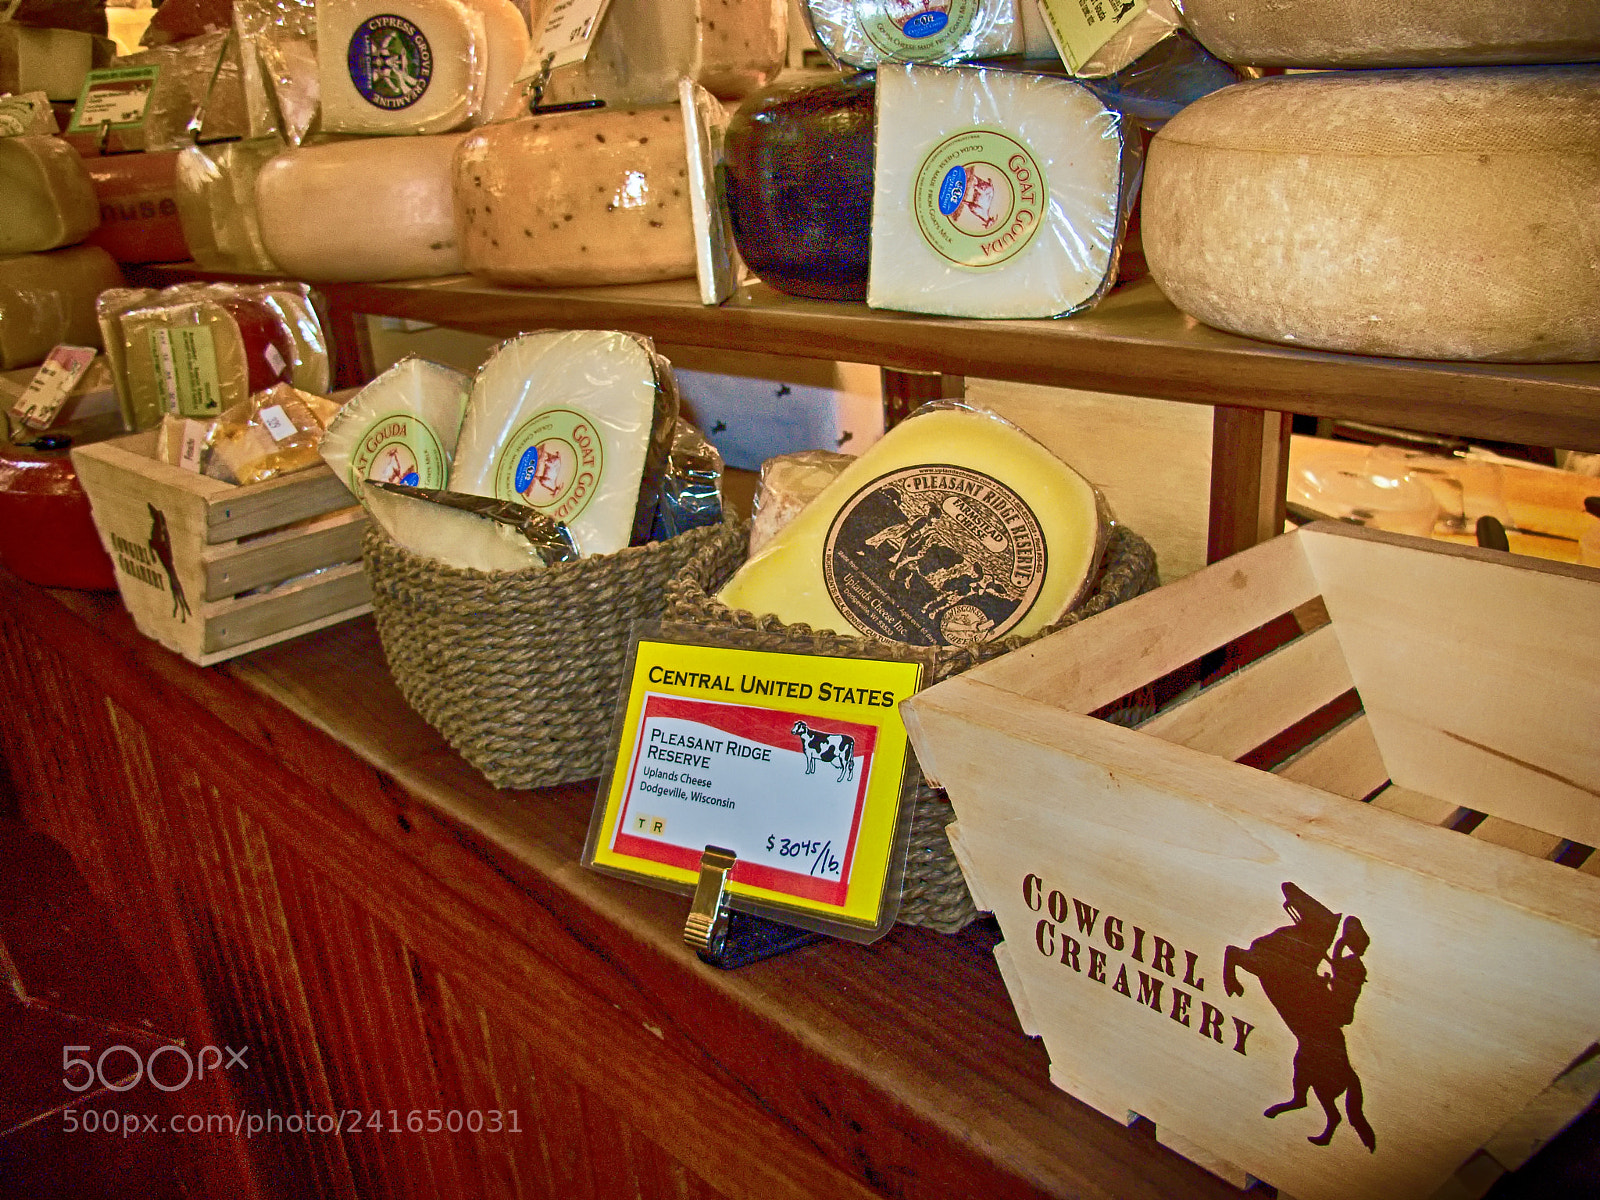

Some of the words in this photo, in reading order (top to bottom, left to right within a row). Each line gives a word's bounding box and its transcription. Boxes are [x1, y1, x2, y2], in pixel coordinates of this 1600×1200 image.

[369, 17, 416, 36] CYPRESS
[415, 35, 430, 76] GROVE
[373, 78, 427, 107] CREAMLINE
[1008, 153, 1037, 205] GOAT
[980, 209, 1034, 257] GOUDA
[366, 422, 408, 454] GOUDA
[572, 424, 594, 467] GOAT
[555, 472, 594, 517] GOUD
[913, 476, 984, 496] PLEASANT
[982, 490, 1021, 525] RIDGE
[1010, 523, 1034, 581] RESERVE
[952, 499, 1003, 542] FARMSTEAD
[955, 513, 988, 541] CHEESE
[843, 572, 872, 602] Uplands
[870, 598, 895, 624] Cheese
[648, 665, 735, 692] CENTRAL
[740, 674, 813, 700] UNITED
[817, 682, 895, 708] STATES
[647, 744, 711, 769] RESERVE
[650, 728, 723, 753] PLEASANT
[726, 740, 772, 762] RIDGE
[639, 781, 689, 801] Dodgeville,
[690, 790, 736, 810] Wisconsin
[643, 766, 678, 782] Uplands
[680, 773, 712, 788] Cheese
[638, 818, 646, 829] T
[653, 821, 663, 833] R
[1022, 873, 1205, 992] COWGIRL
[1035, 919, 1255, 1056] CREAMERY
